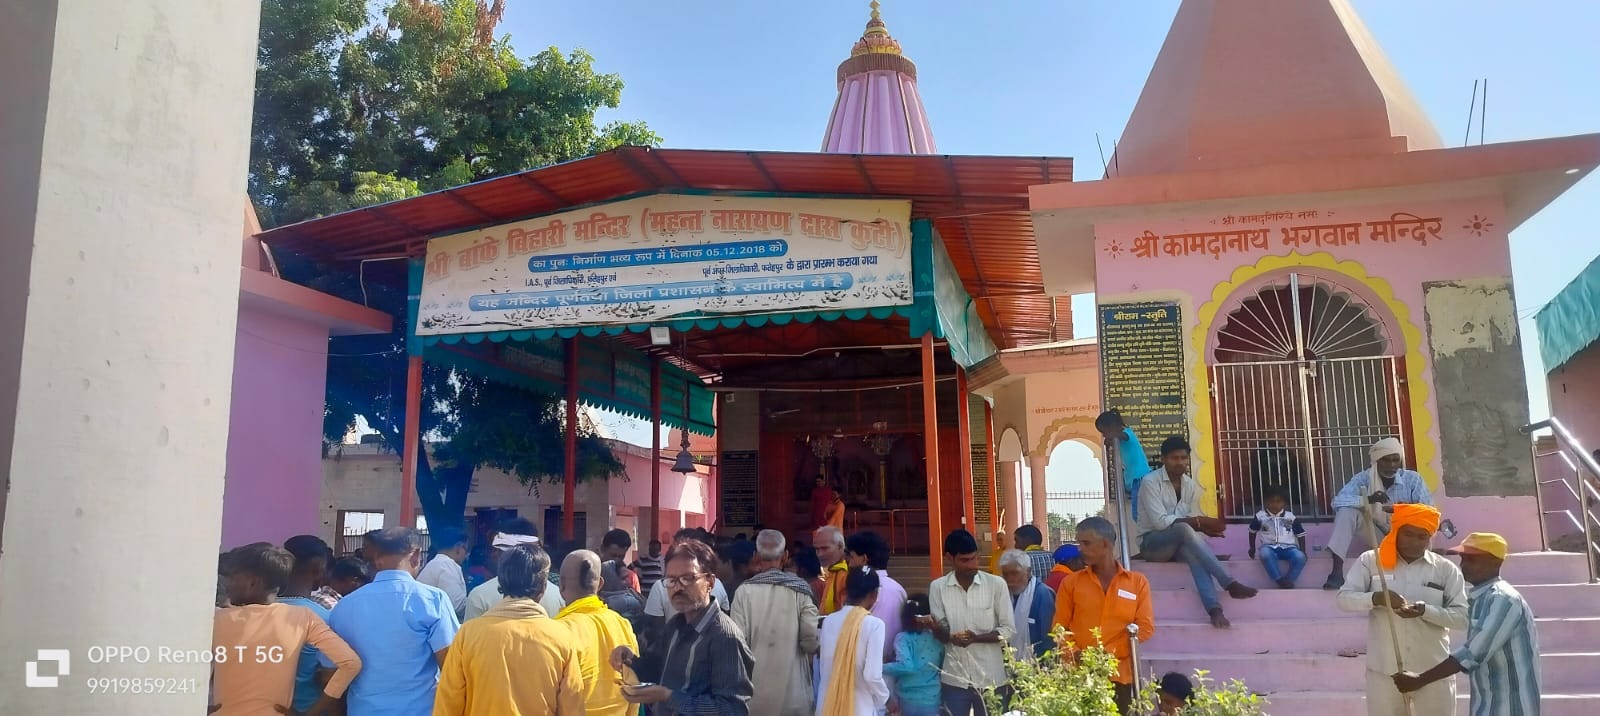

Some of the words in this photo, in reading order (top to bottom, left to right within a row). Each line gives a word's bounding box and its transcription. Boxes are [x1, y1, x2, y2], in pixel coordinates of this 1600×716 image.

[573, 212, 631, 243] मन्दिर
[710, 209, 792, 233] नारायण
[799, 212, 841, 240] दास
[1130, 230, 1159, 258] श्री
[1162, 228, 1270, 260] कामदानाथ
[1281, 222, 1362, 248] भगवान
[1366, 212, 1442, 246] मन्दिर
[533, 260, 545, 268] का
[573, 254, 605, 265] निर्माण
[610, 254, 630, 263] भव्य
[635, 253, 652, 262] रूप
[656, 248, 665, 260] में
[670, 247, 702, 259] दिनांक
[706, 245, 765, 257] 05.12.2018
[769, 241, 783, 253] को
[786, 258, 795, 270] के
[796, 258, 811, 271] द्वारा
[813, 257, 835, 270] प्रारम्भ
[837, 255, 860, 267] कराया
[861, 254, 877, 266] गया
[615, 288, 652, 300] जिला
[811, 274, 825, 289] में
